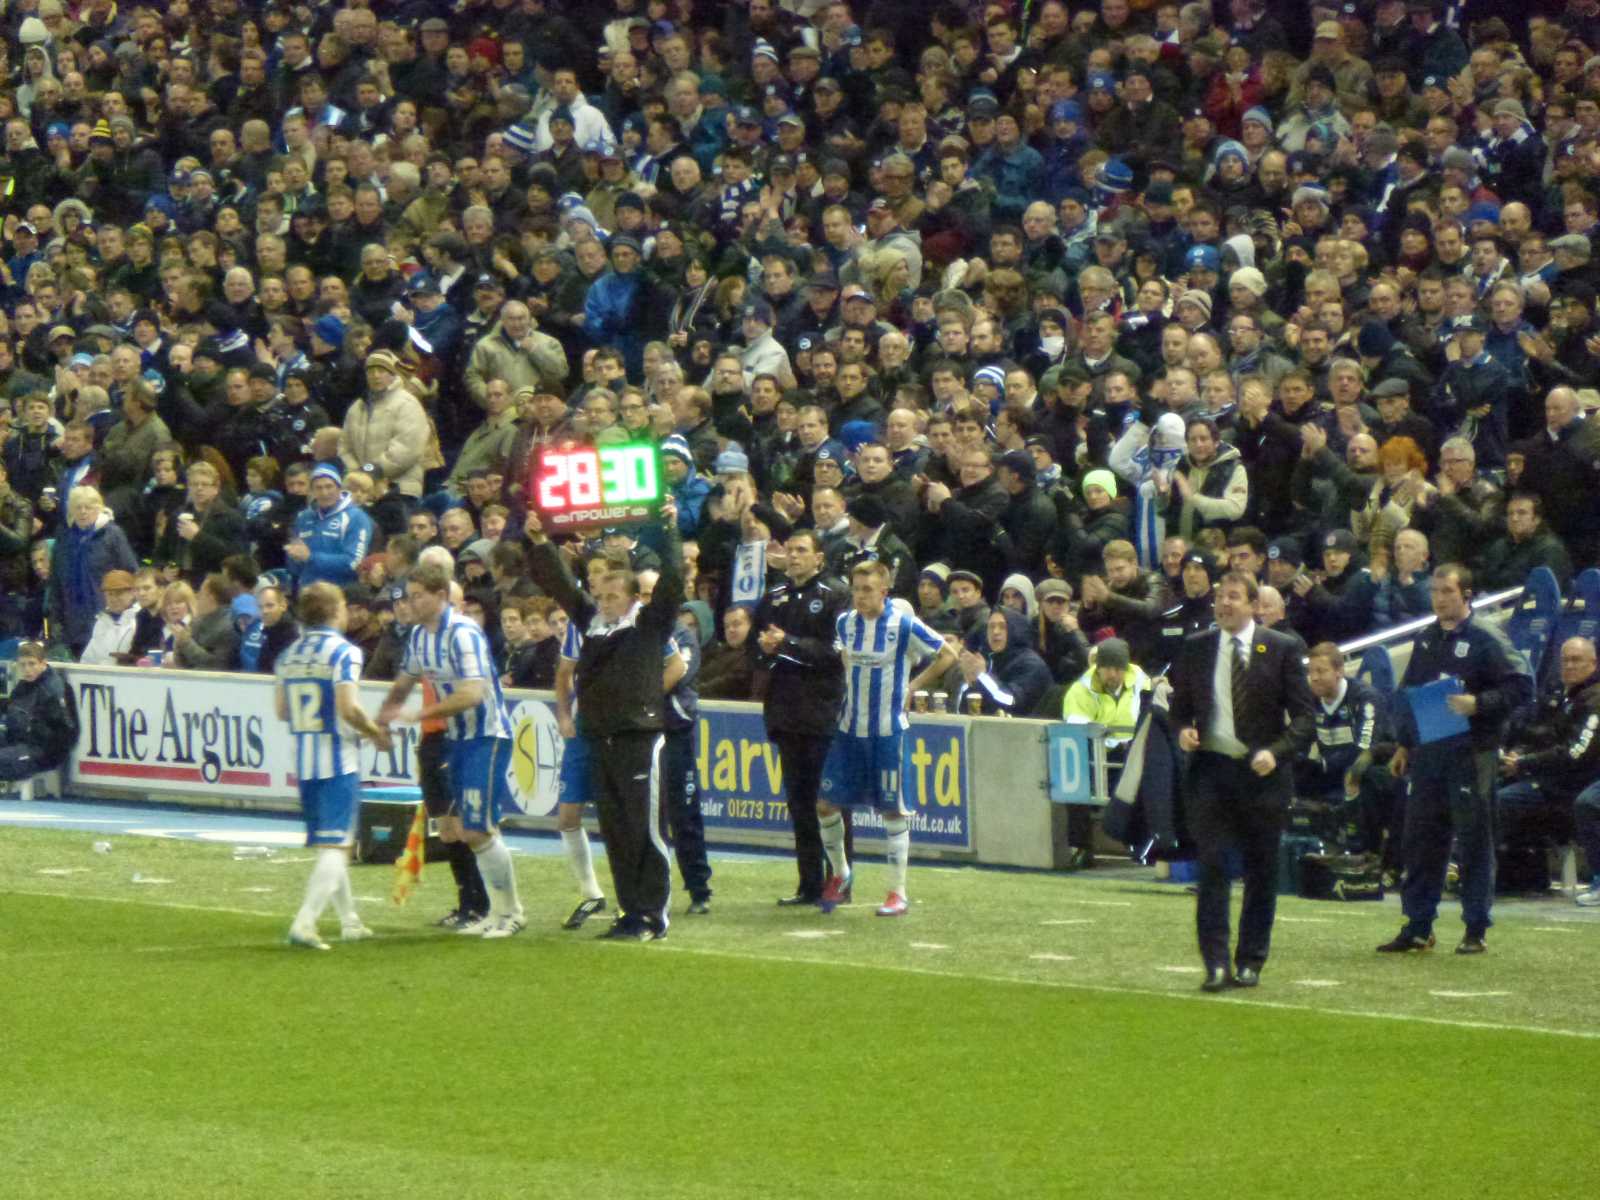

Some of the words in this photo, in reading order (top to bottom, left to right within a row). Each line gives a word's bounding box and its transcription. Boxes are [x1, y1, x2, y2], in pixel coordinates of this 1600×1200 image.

[540, 451, 601, 508] 28
[600, 446, 658, 503] 30
[79, 683, 148, 761] The
[155, 687, 264, 784] Argus
[287, 683, 324, 732] 12
[696, 719, 783, 795] Harv
[910, 736, 960, 807] td
[1059, 736, 1080, 793] D
[727, 798, 765, 820] 01273
[767, 801, 789, 821] 777
